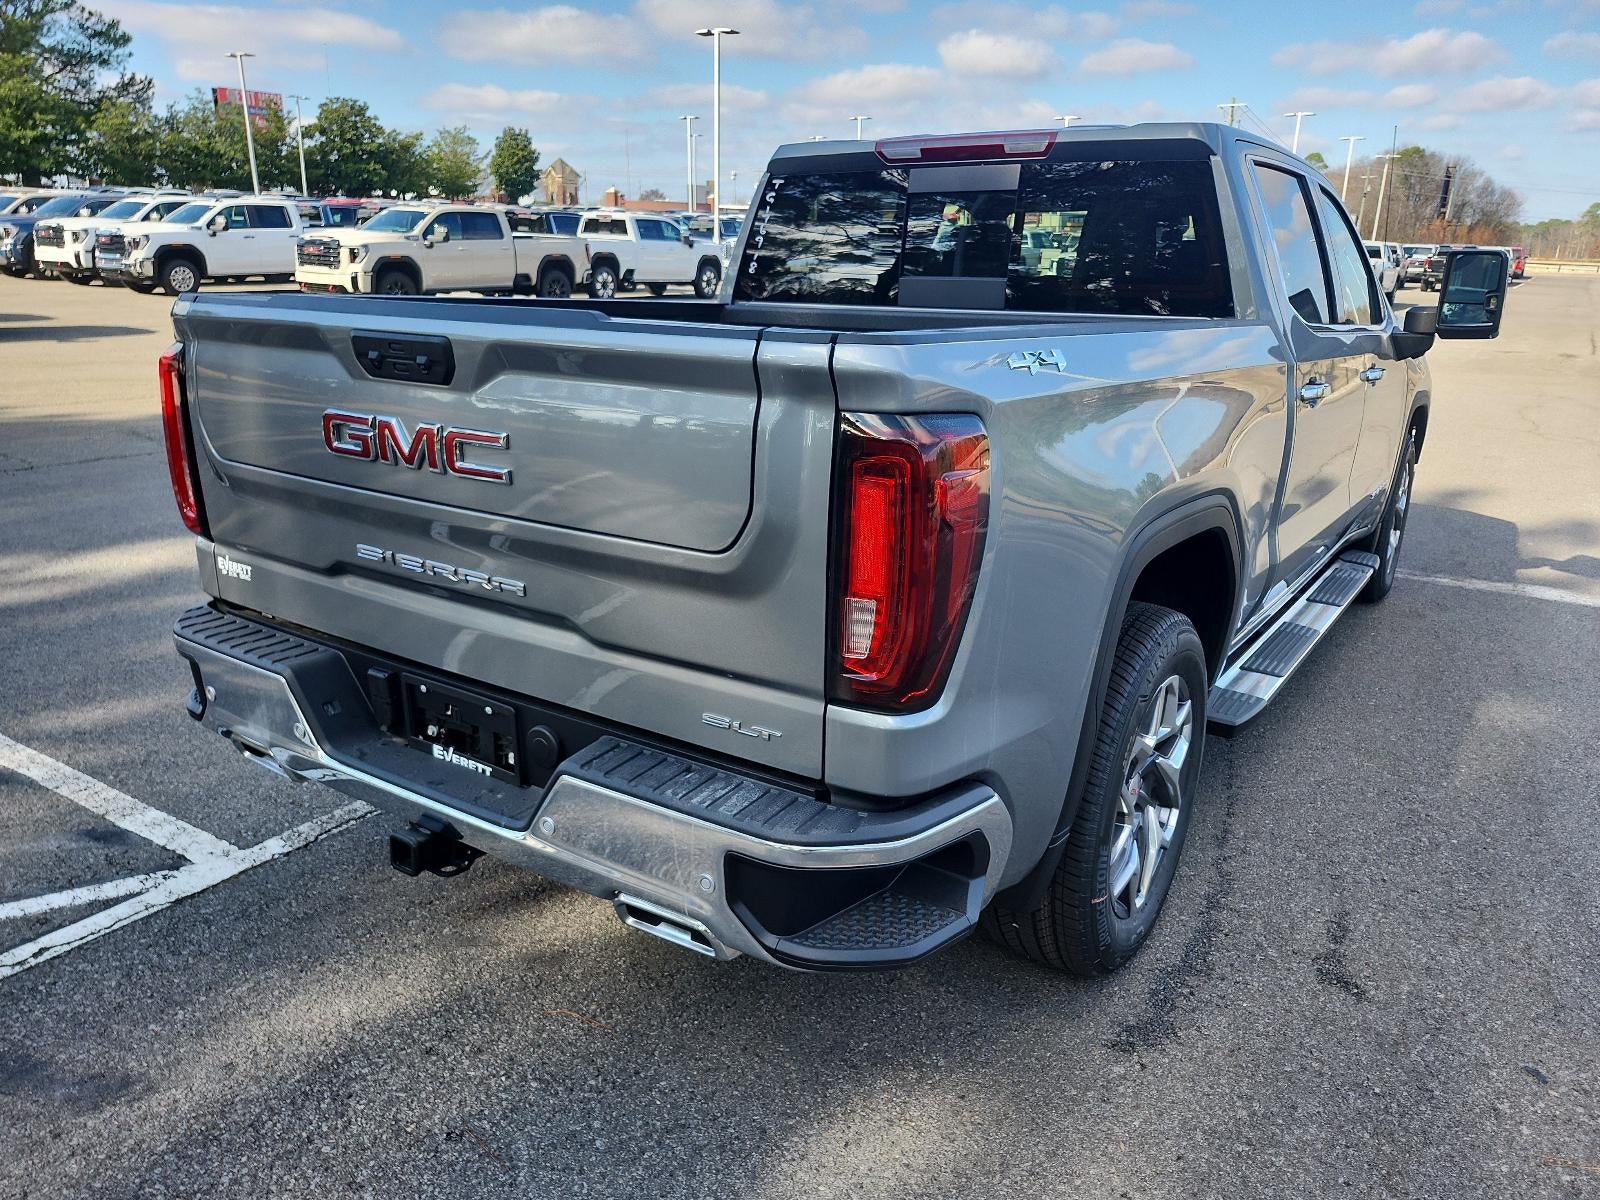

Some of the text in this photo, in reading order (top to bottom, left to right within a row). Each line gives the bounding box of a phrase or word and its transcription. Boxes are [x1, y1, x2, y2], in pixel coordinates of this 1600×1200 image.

[322, 407, 513, 486] GMC
[217, 554, 252, 577] EVERETT
[356, 543, 527, 598] SIERRA
[702, 712, 783, 742] SLT
[432, 743, 493, 777] EVERETT
